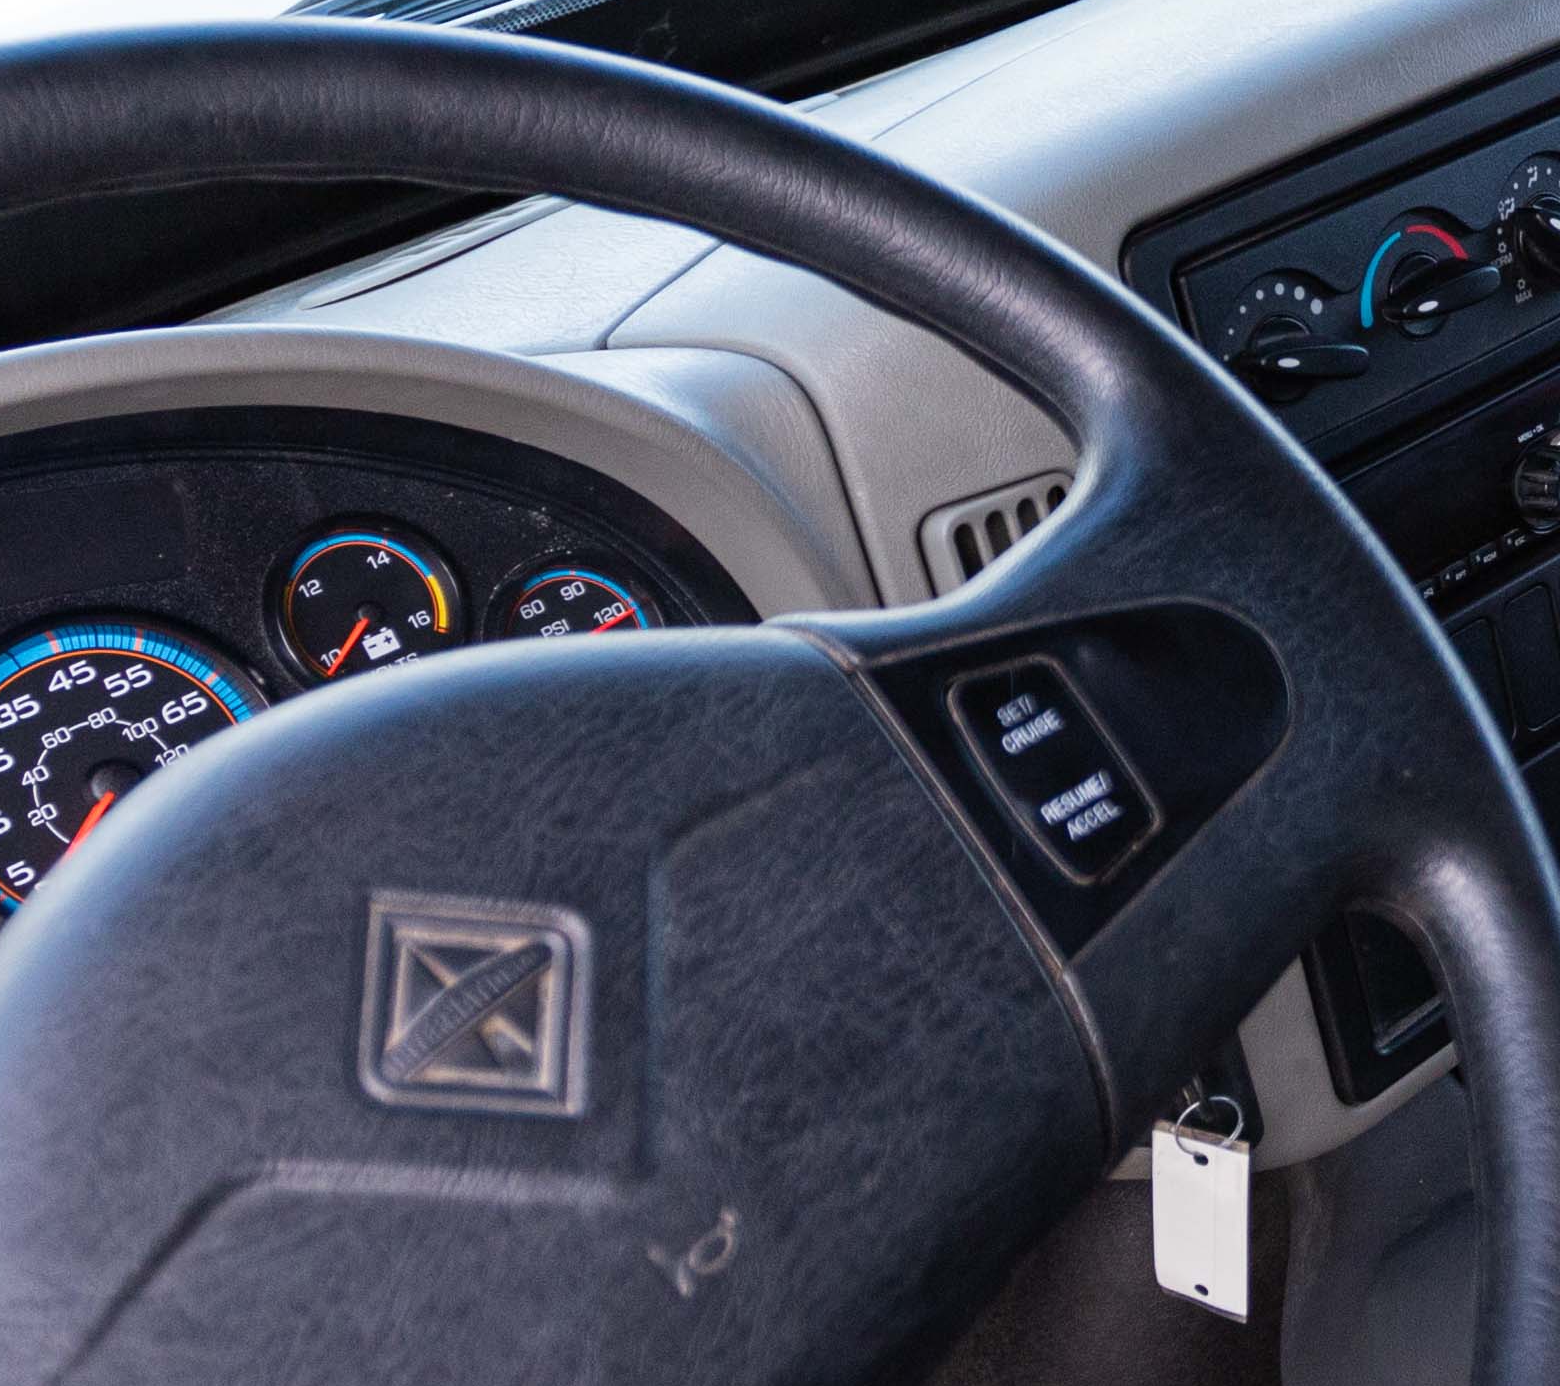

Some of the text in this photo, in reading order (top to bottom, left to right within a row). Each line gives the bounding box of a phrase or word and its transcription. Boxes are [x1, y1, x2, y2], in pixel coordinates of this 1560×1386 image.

[367, 551, 391, 570] 14
[298, 579, 323, 599] 12
[560, 581, 586, 602] 90
[407, 610, 431, 630] 16
[519, 598, 546, 620] 60
[540, 618, 570, 640] PSI
[48, 660, 97, 693] 45
[103, 664, 153, 697] 55
[88, 707, 116, 729] 80
[161, 691, 208, 725] 65
[41, 727, 71, 750] 60
[122, 717, 159, 741] 100
[1002, 707, 1066, 755] CRUISE
[21, 765, 50, 787] 40
[27, 803, 57, 826] 20
[1067, 797, 1123, 842] ACCEL
[6, 861, 35, 887] 5
